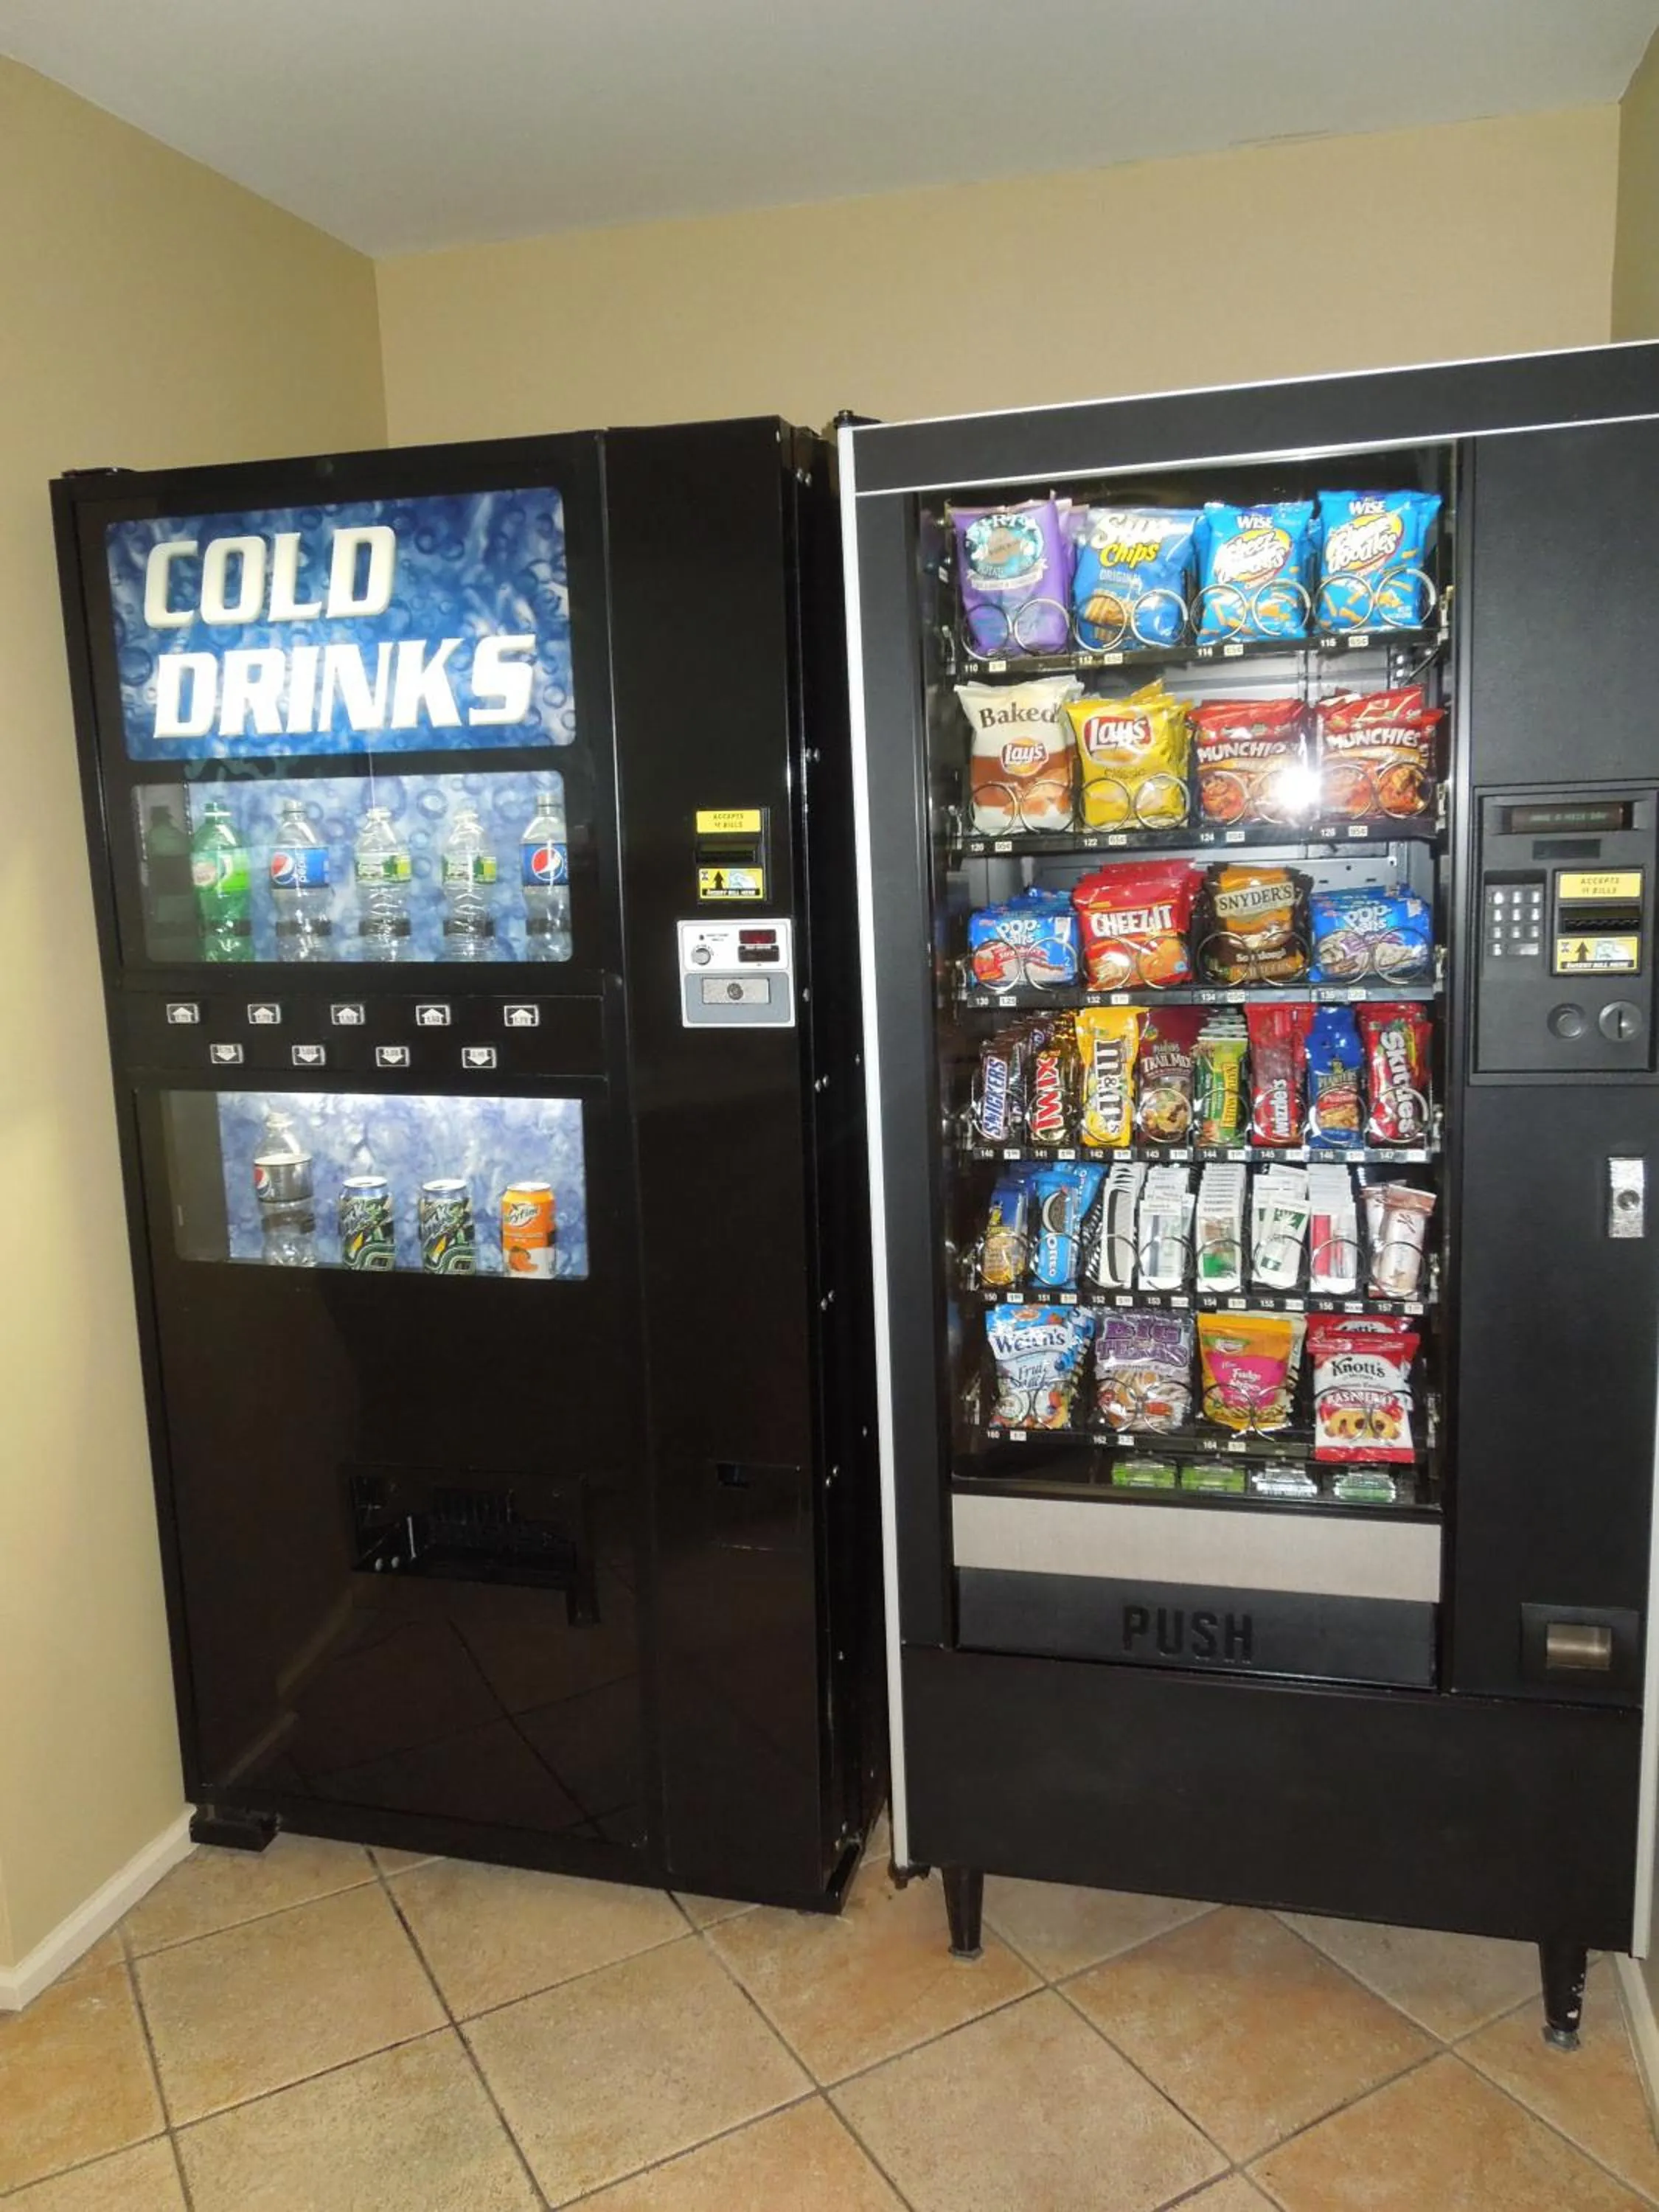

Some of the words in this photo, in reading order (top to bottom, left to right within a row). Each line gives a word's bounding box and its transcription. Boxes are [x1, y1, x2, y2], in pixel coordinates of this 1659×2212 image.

[1349, 498, 1387, 515] WISE
[1237, 515, 1275, 529] WISE
[1099, 542, 1162, 570] Chips
[145, 525, 396, 629] COLD
[964, 664, 978, 673] 110
[153, 634, 535, 738] DRINKS
[1327, 727, 1422, 749] MUNCHIES
[1218, 885, 1293, 911] SNYDER'S
[1086, 995, 1101, 1004] 132
[1036, 1057, 1062, 1133] TWIX
[1380, 1032, 1415, 1133] Skittles
[983, 1057, 1007, 1138] SNICKERS
[1332, 1357, 1385, 1378] Knott's
[1123, 1604, 1252, 1660] PUSH
